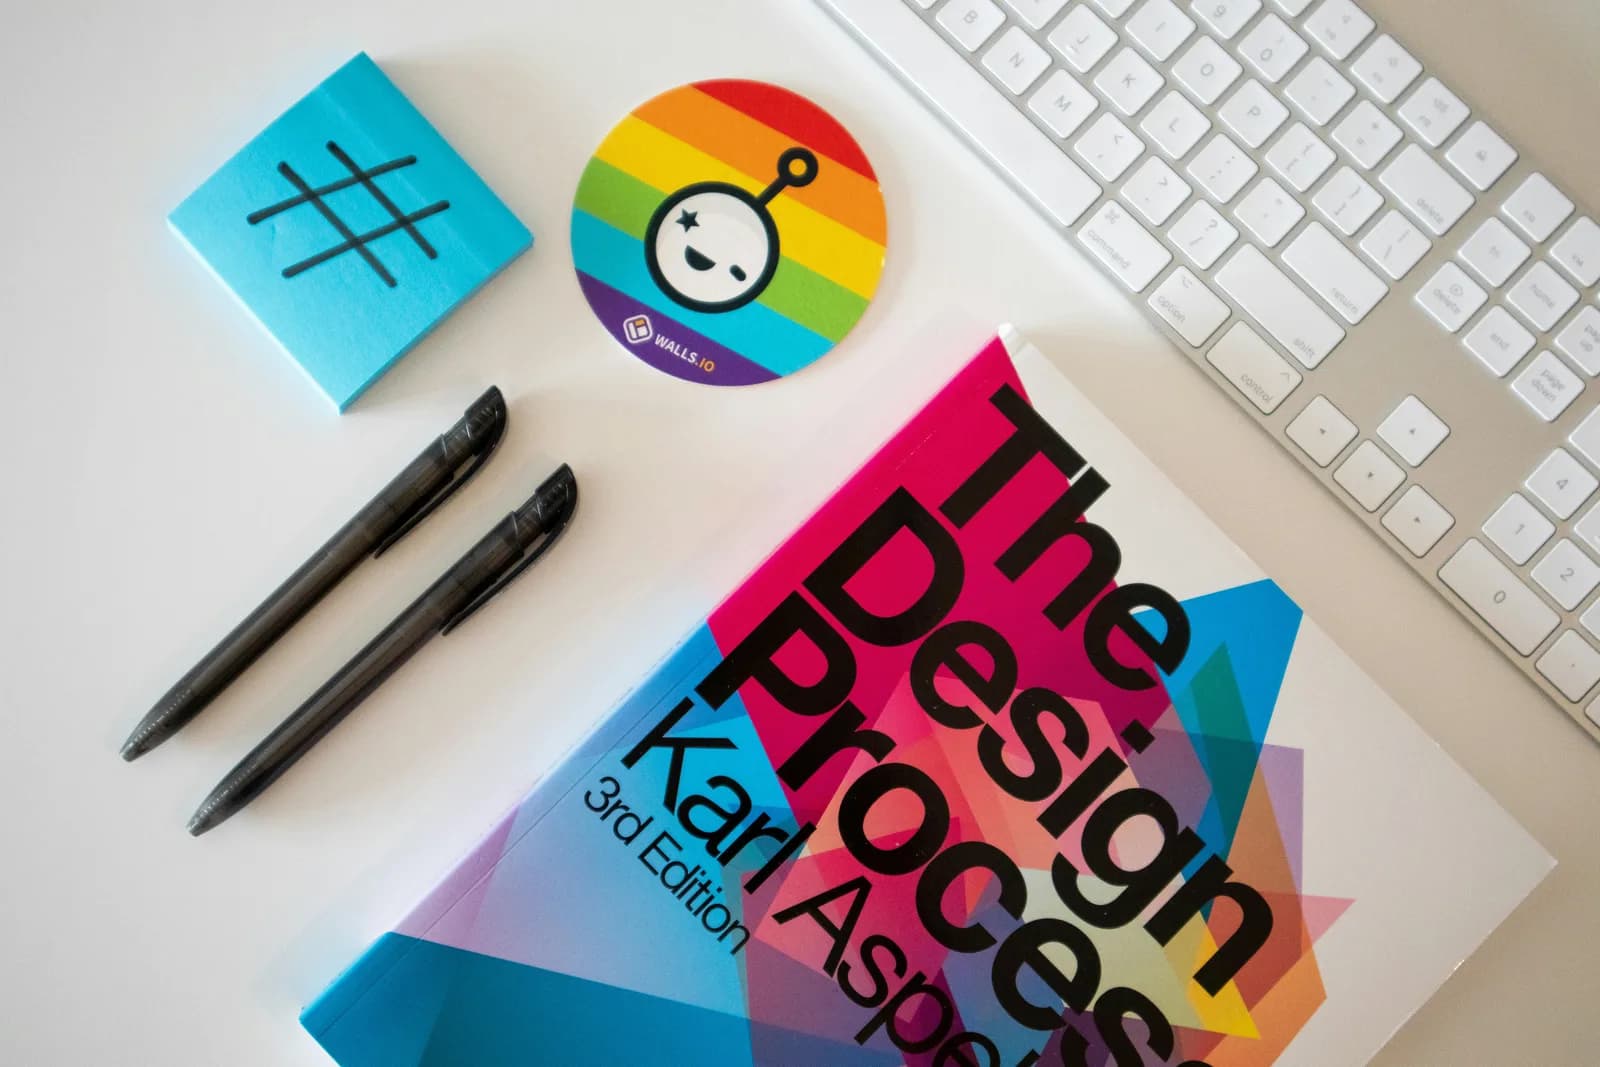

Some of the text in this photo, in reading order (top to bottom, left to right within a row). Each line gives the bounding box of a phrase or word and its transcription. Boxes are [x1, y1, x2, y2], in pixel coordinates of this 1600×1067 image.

[963, 10, 978, 24] B
[1076, 33, 1090, 45] J
[1009, 52, 1024, 68] N
[1121, 73, 1136, 88] K
[1054, 95, 1072, 112] M
[1247, 105, 1261, 117] P
[1168, 117, 1180, 133] L
[1087, 229, 1131, 269] command
[1157, 295, 1187, 324] option
[654, 334, 716, 373] WALLS.IO
[1240, 373, 1276, 404] control
[938, 383, 1191, 692] The
[1515, 523, 1526, 535] 1
[1559, 567, 1575, 582] 2
[1493, 589, 1507, 605] 0
[801, 485, 1274, 998] Design
[694, 590, 1215, 1067] Proces
[584, 775, 750, 956] 3rd Edition
[621, 696, 1041, 1067] Karl Aspe
